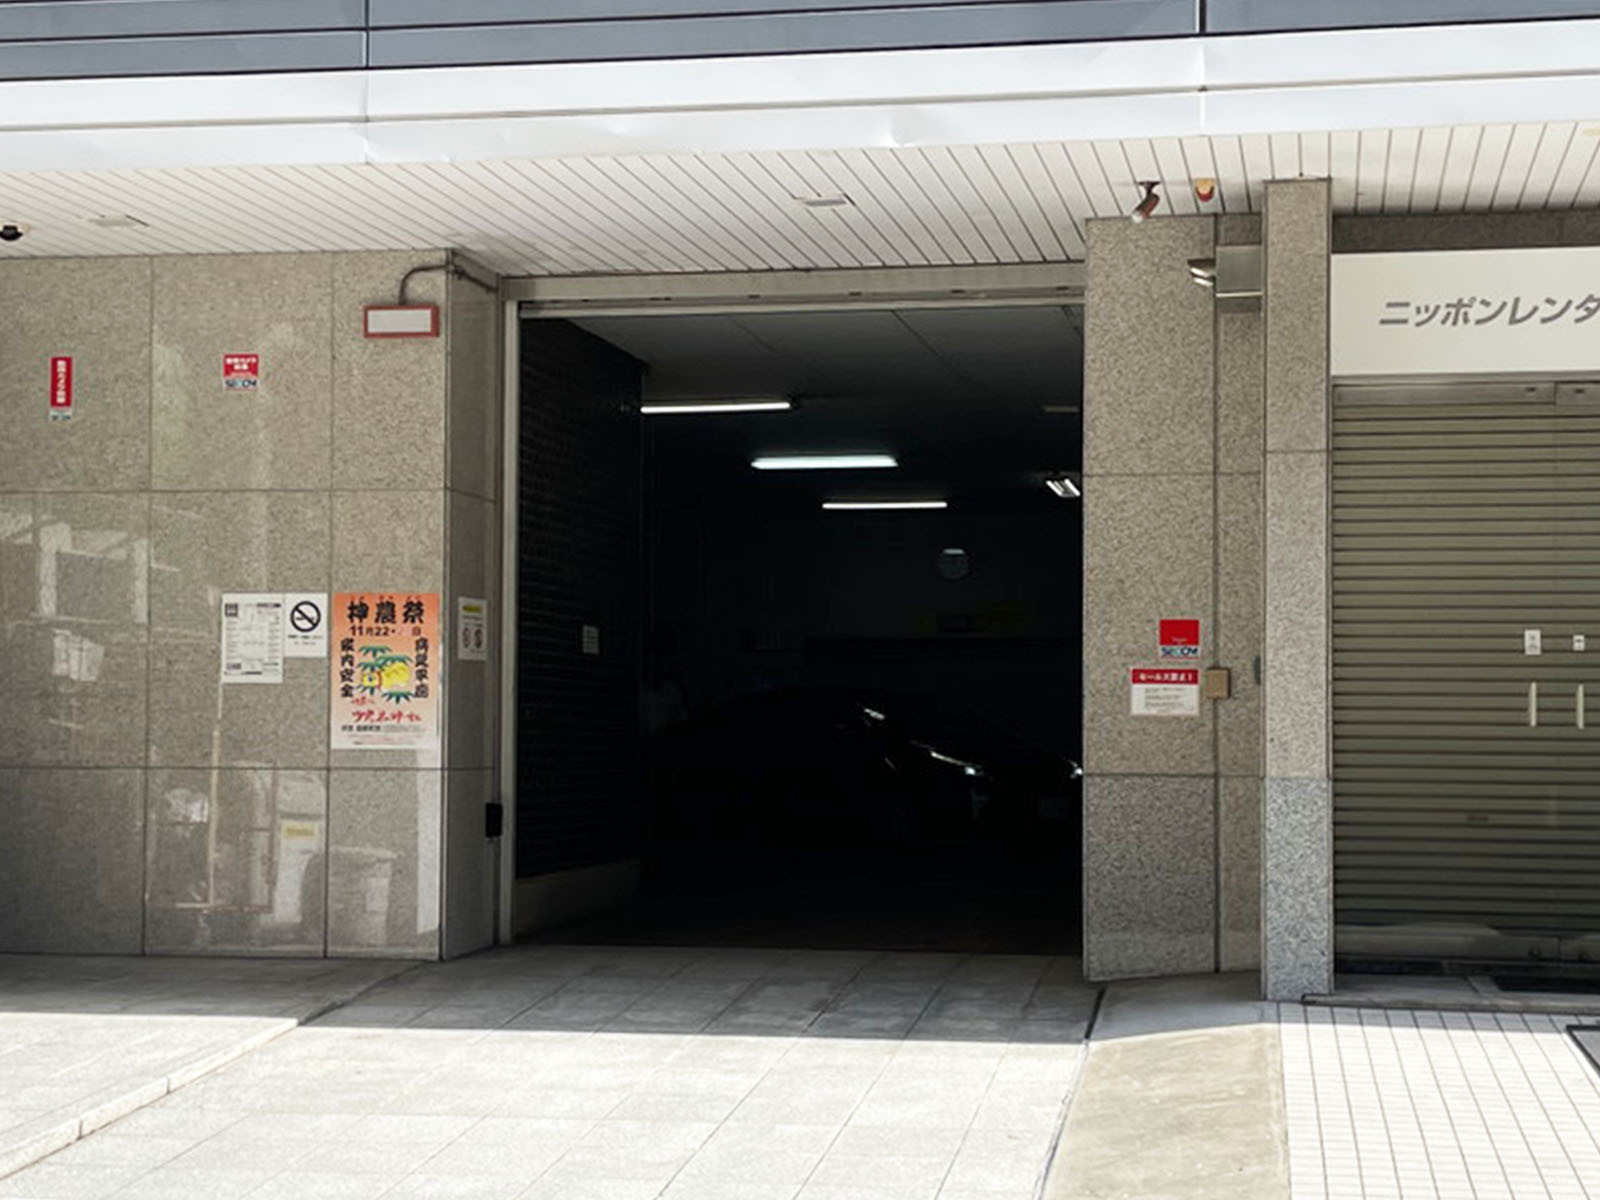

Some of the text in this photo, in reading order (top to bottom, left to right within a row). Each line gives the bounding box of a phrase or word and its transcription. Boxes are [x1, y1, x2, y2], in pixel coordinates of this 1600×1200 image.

[1379, 293, 1600, 327] ニッポンレンタ
[347, 600, 424, 624] 神農祭
